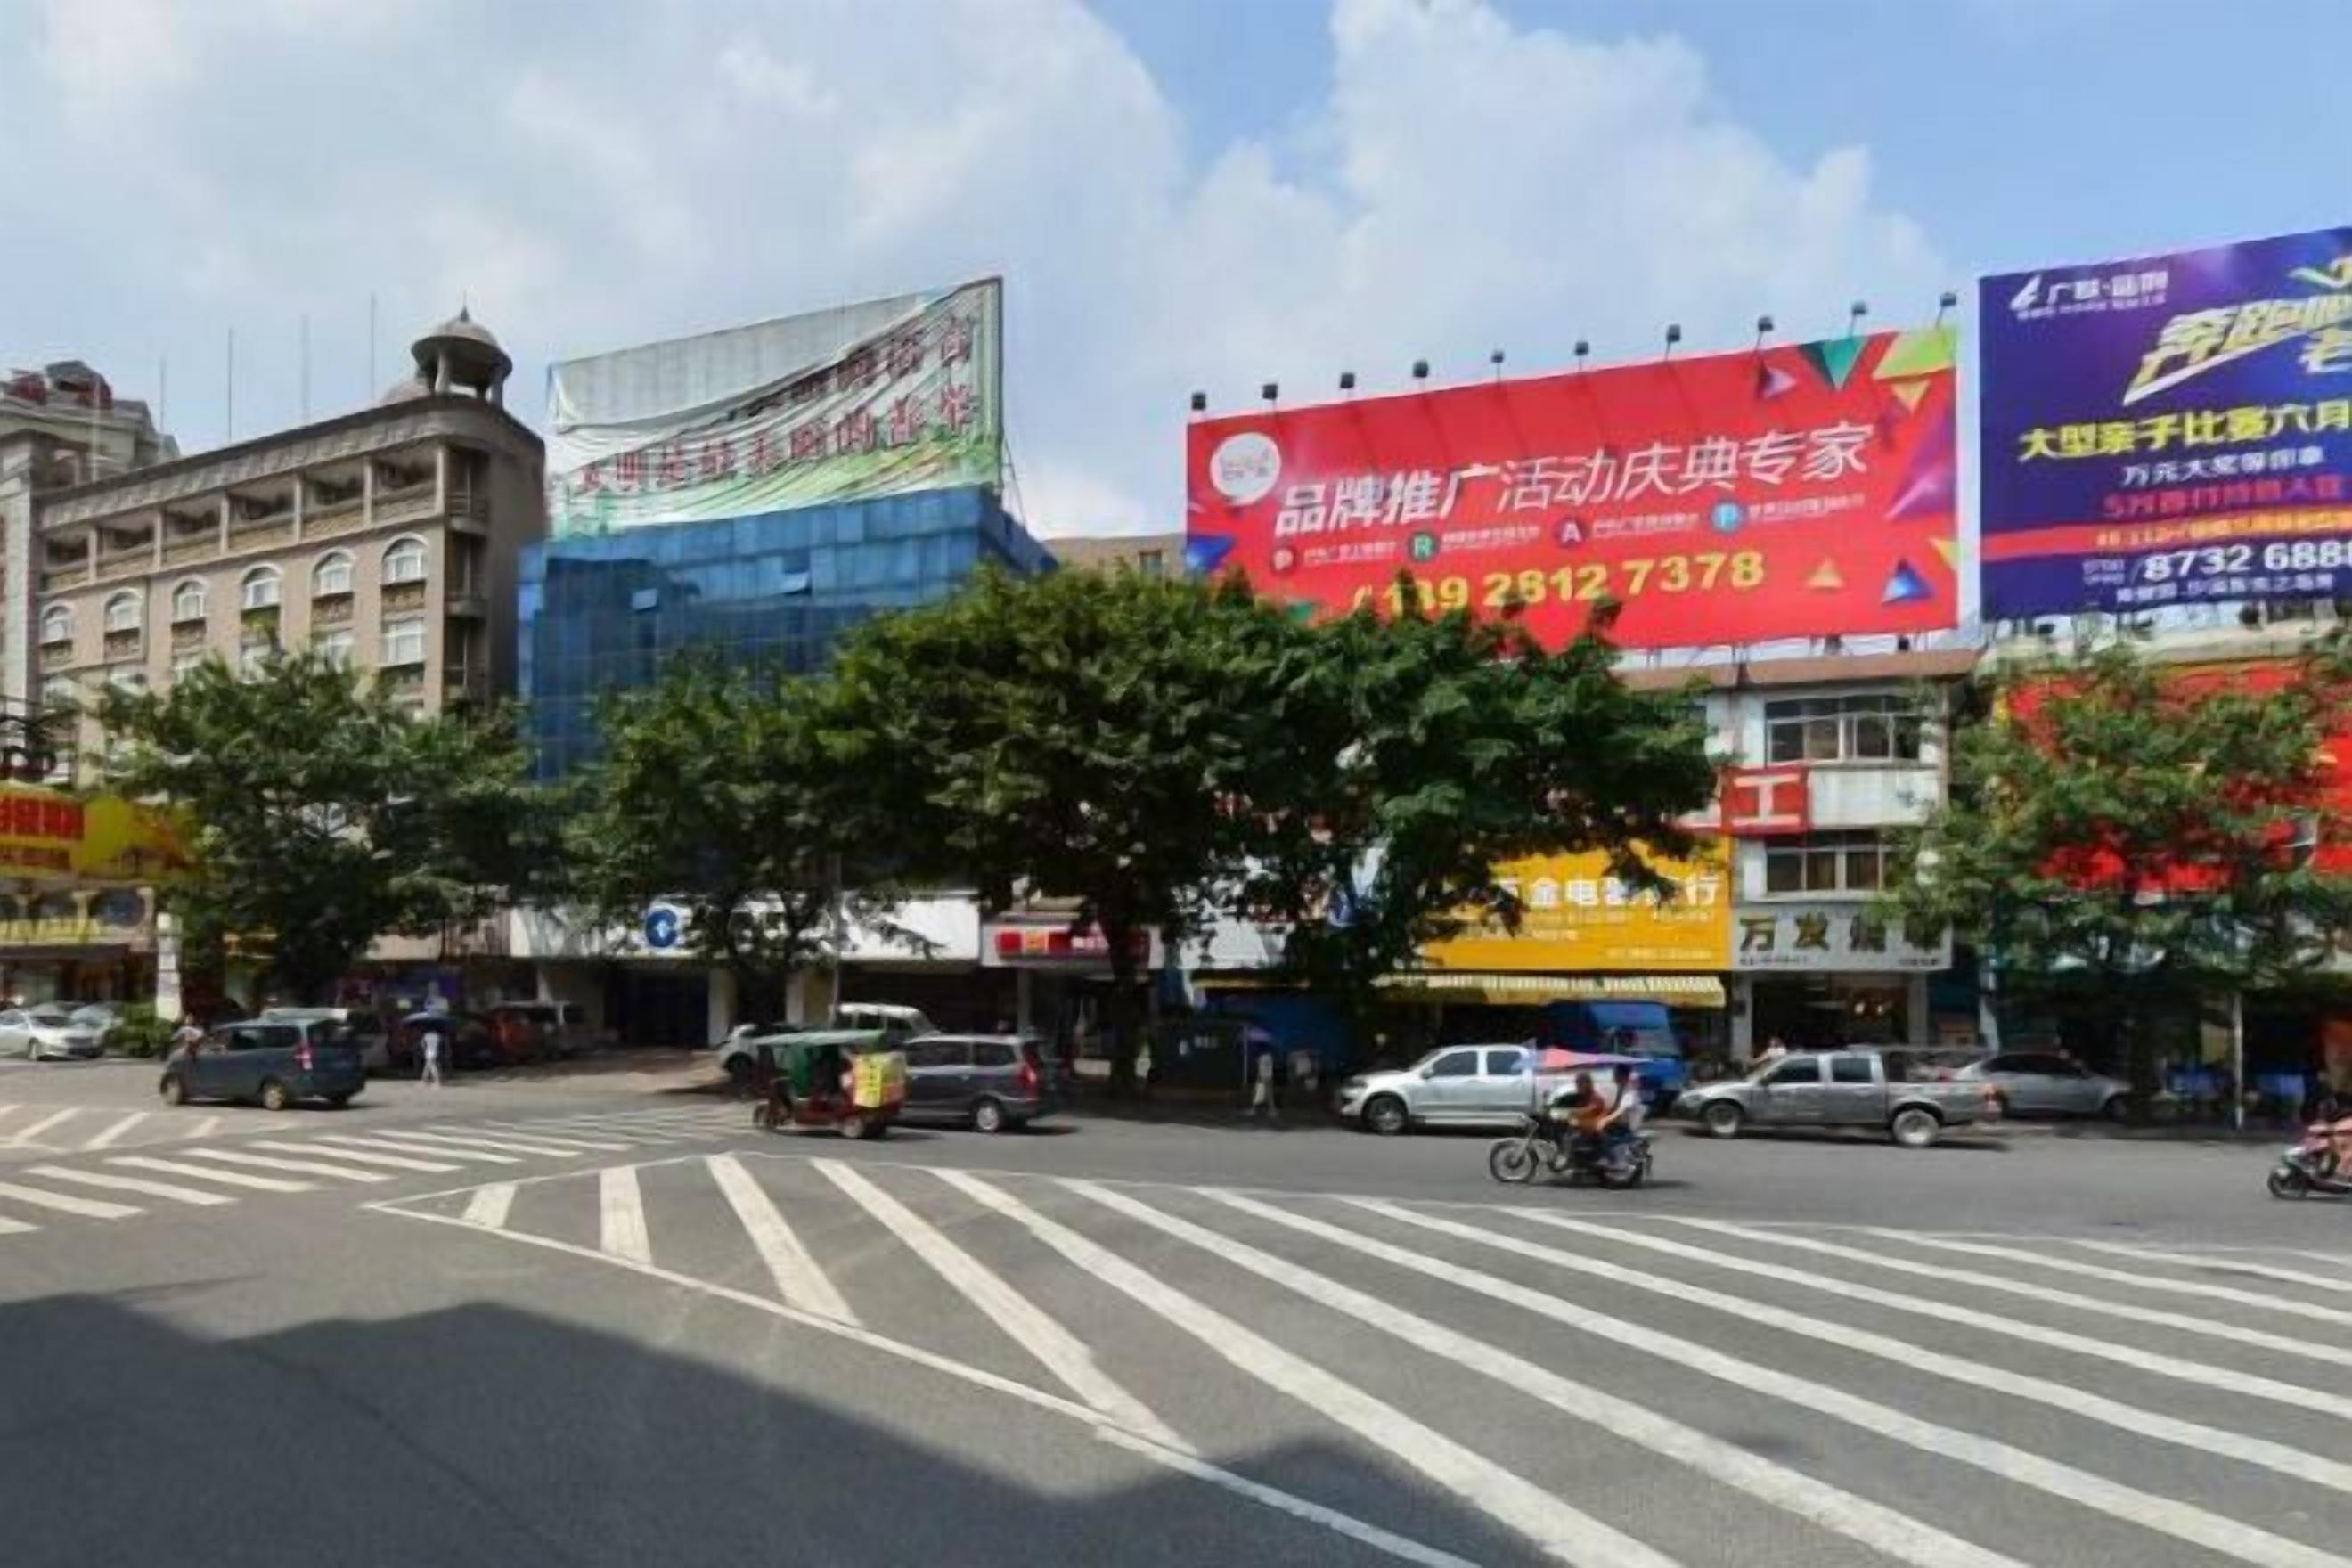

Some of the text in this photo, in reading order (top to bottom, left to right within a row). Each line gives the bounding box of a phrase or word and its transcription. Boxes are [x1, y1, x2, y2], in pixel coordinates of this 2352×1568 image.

[1275, 420, 1874, 536] 品牌推广活动庆典专家
[1622, 551, 1765, 596] 7378
[2143, 544, 2252, 581] 8732
[2264, 539, 2352, 570] 688
